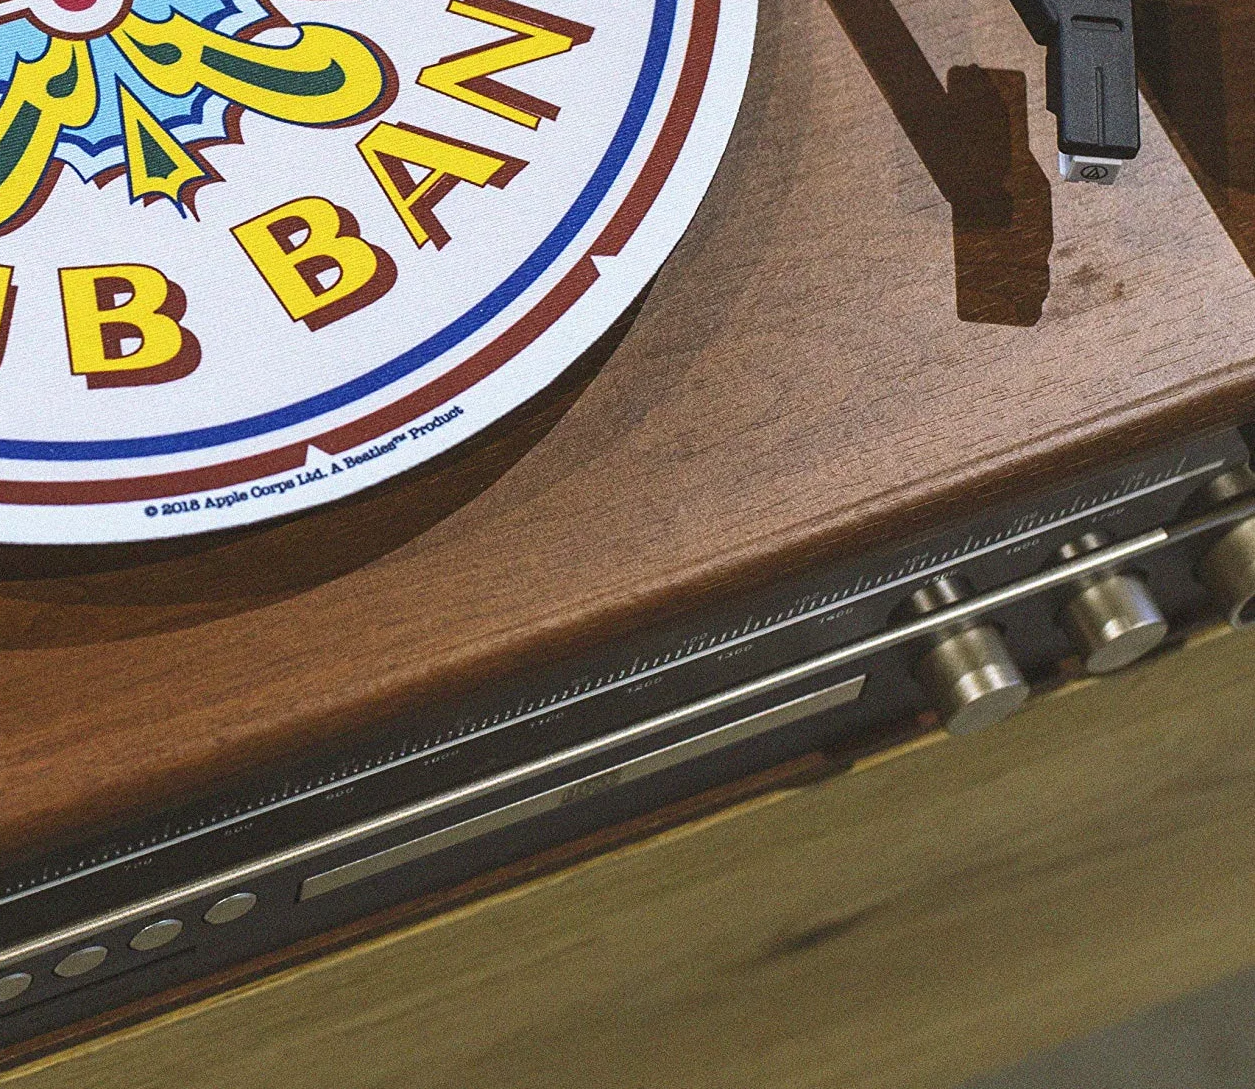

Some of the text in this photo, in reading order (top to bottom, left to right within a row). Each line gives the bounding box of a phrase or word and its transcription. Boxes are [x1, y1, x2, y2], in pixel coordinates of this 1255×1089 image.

[161, 499, 201, 516] 2018
[204, 491, 248, 509] Apple
[250, 480, 296, 499] Corps
[296, 468, 328, 486] Ltd.
[331, 462, 343, 475] A
[408, 405, 464, 441] Product
